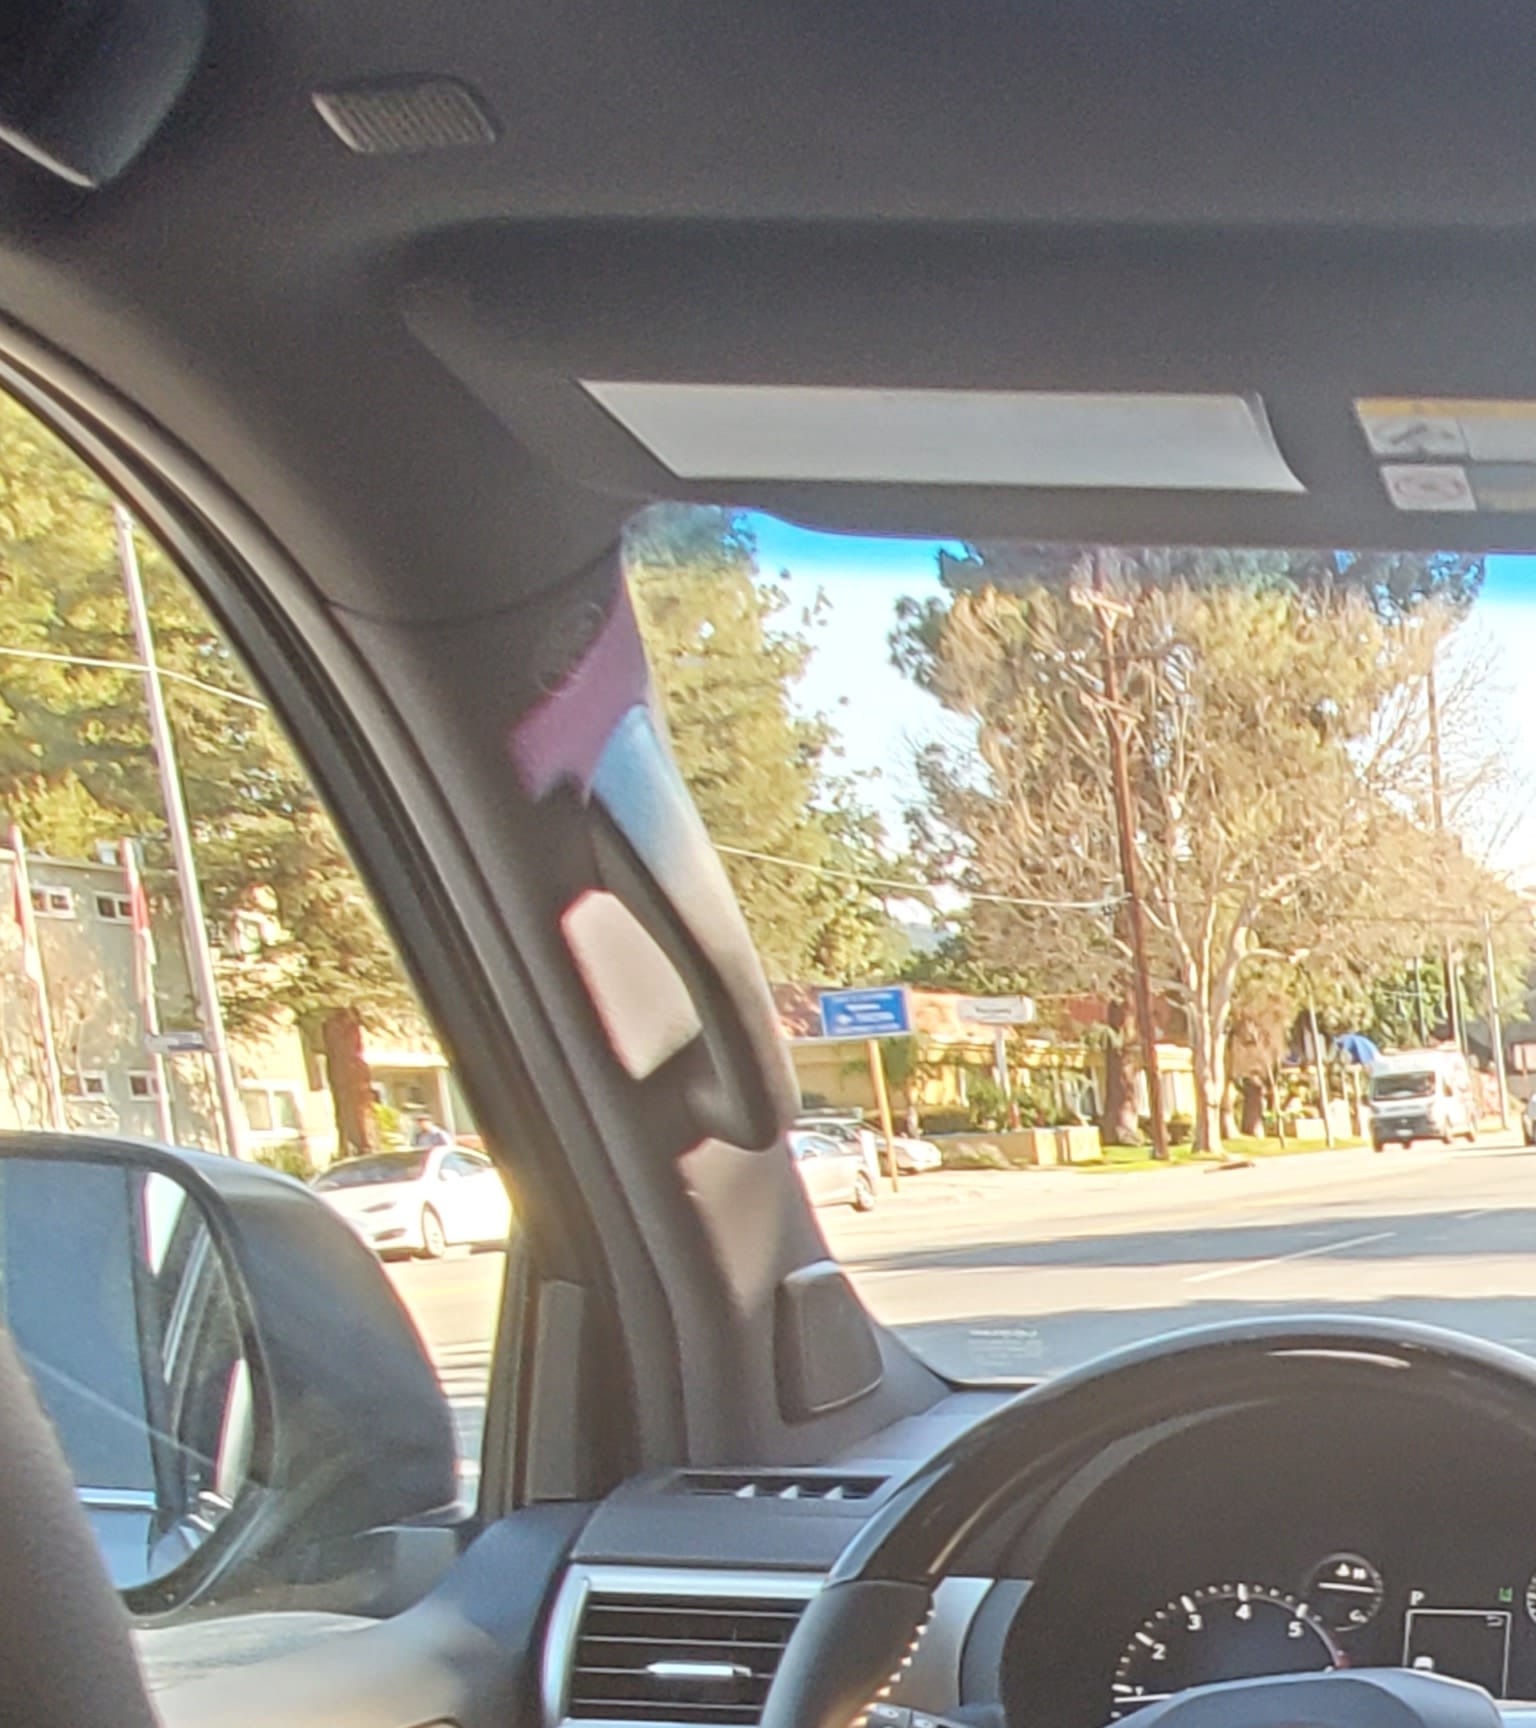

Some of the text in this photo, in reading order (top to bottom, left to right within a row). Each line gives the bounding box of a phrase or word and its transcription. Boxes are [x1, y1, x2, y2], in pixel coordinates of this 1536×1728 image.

[1235, 1604, 1251, 1620] 4
[1188, 1615, 1202, 1631] 3
[1288, 1622, 1302, 1638] 5
[1152, 1644, 1166, 1660] 2
